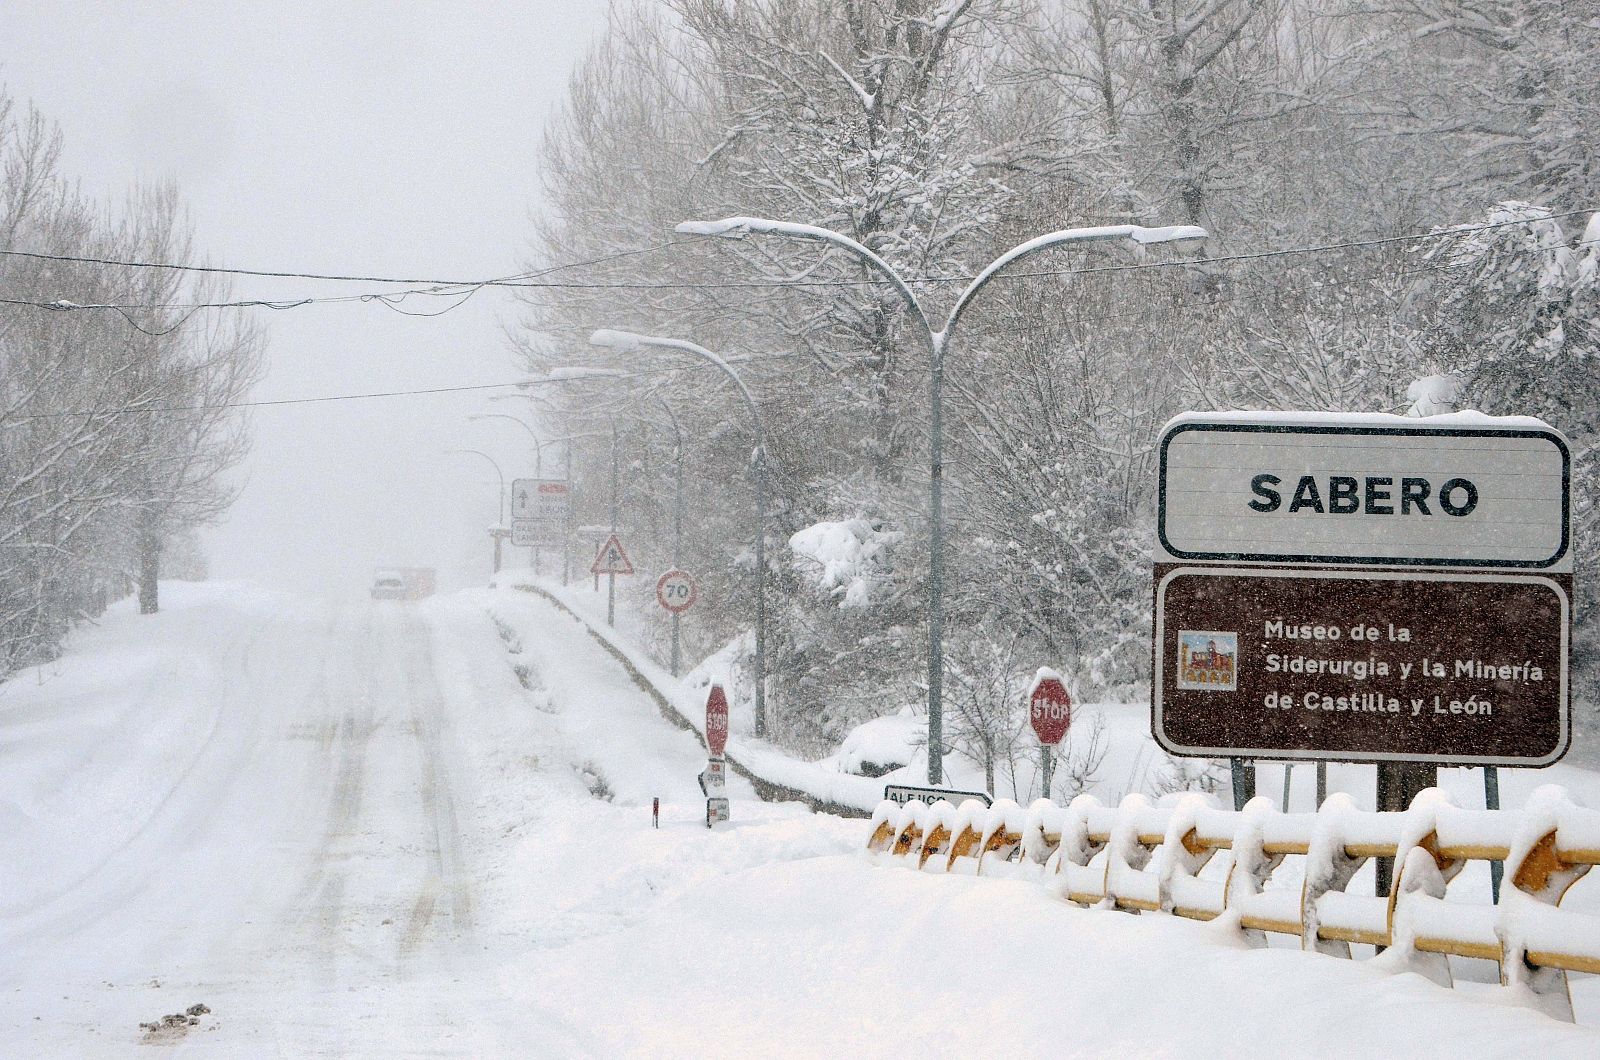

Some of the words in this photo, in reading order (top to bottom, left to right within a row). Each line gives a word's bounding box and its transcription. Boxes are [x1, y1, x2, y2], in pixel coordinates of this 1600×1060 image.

[1247, 474, 1479, 517] SABERO
[667, 584, 689, 599] 70
[1265, 621, 1341, 642] Museo
[1350, 623, 1379, 642] de
[1388, 625, 1411, 642] la
[1265, 654, 1389, 680] Siderurgia
[1400, 664, 1413, 679] y
[1423, 657, 1444, 678] la
[1455, 659, 1543, 682] Minería
[1032, 698, 1069, 720] STOP
[1264, 692, 1293, 709] de
[1303, 693, 1400, 713] Castilla
[1411, 700, 1424, 715] y
[1434, 695, 1492, 715] León
[707, 713, 727, 730] STOP
